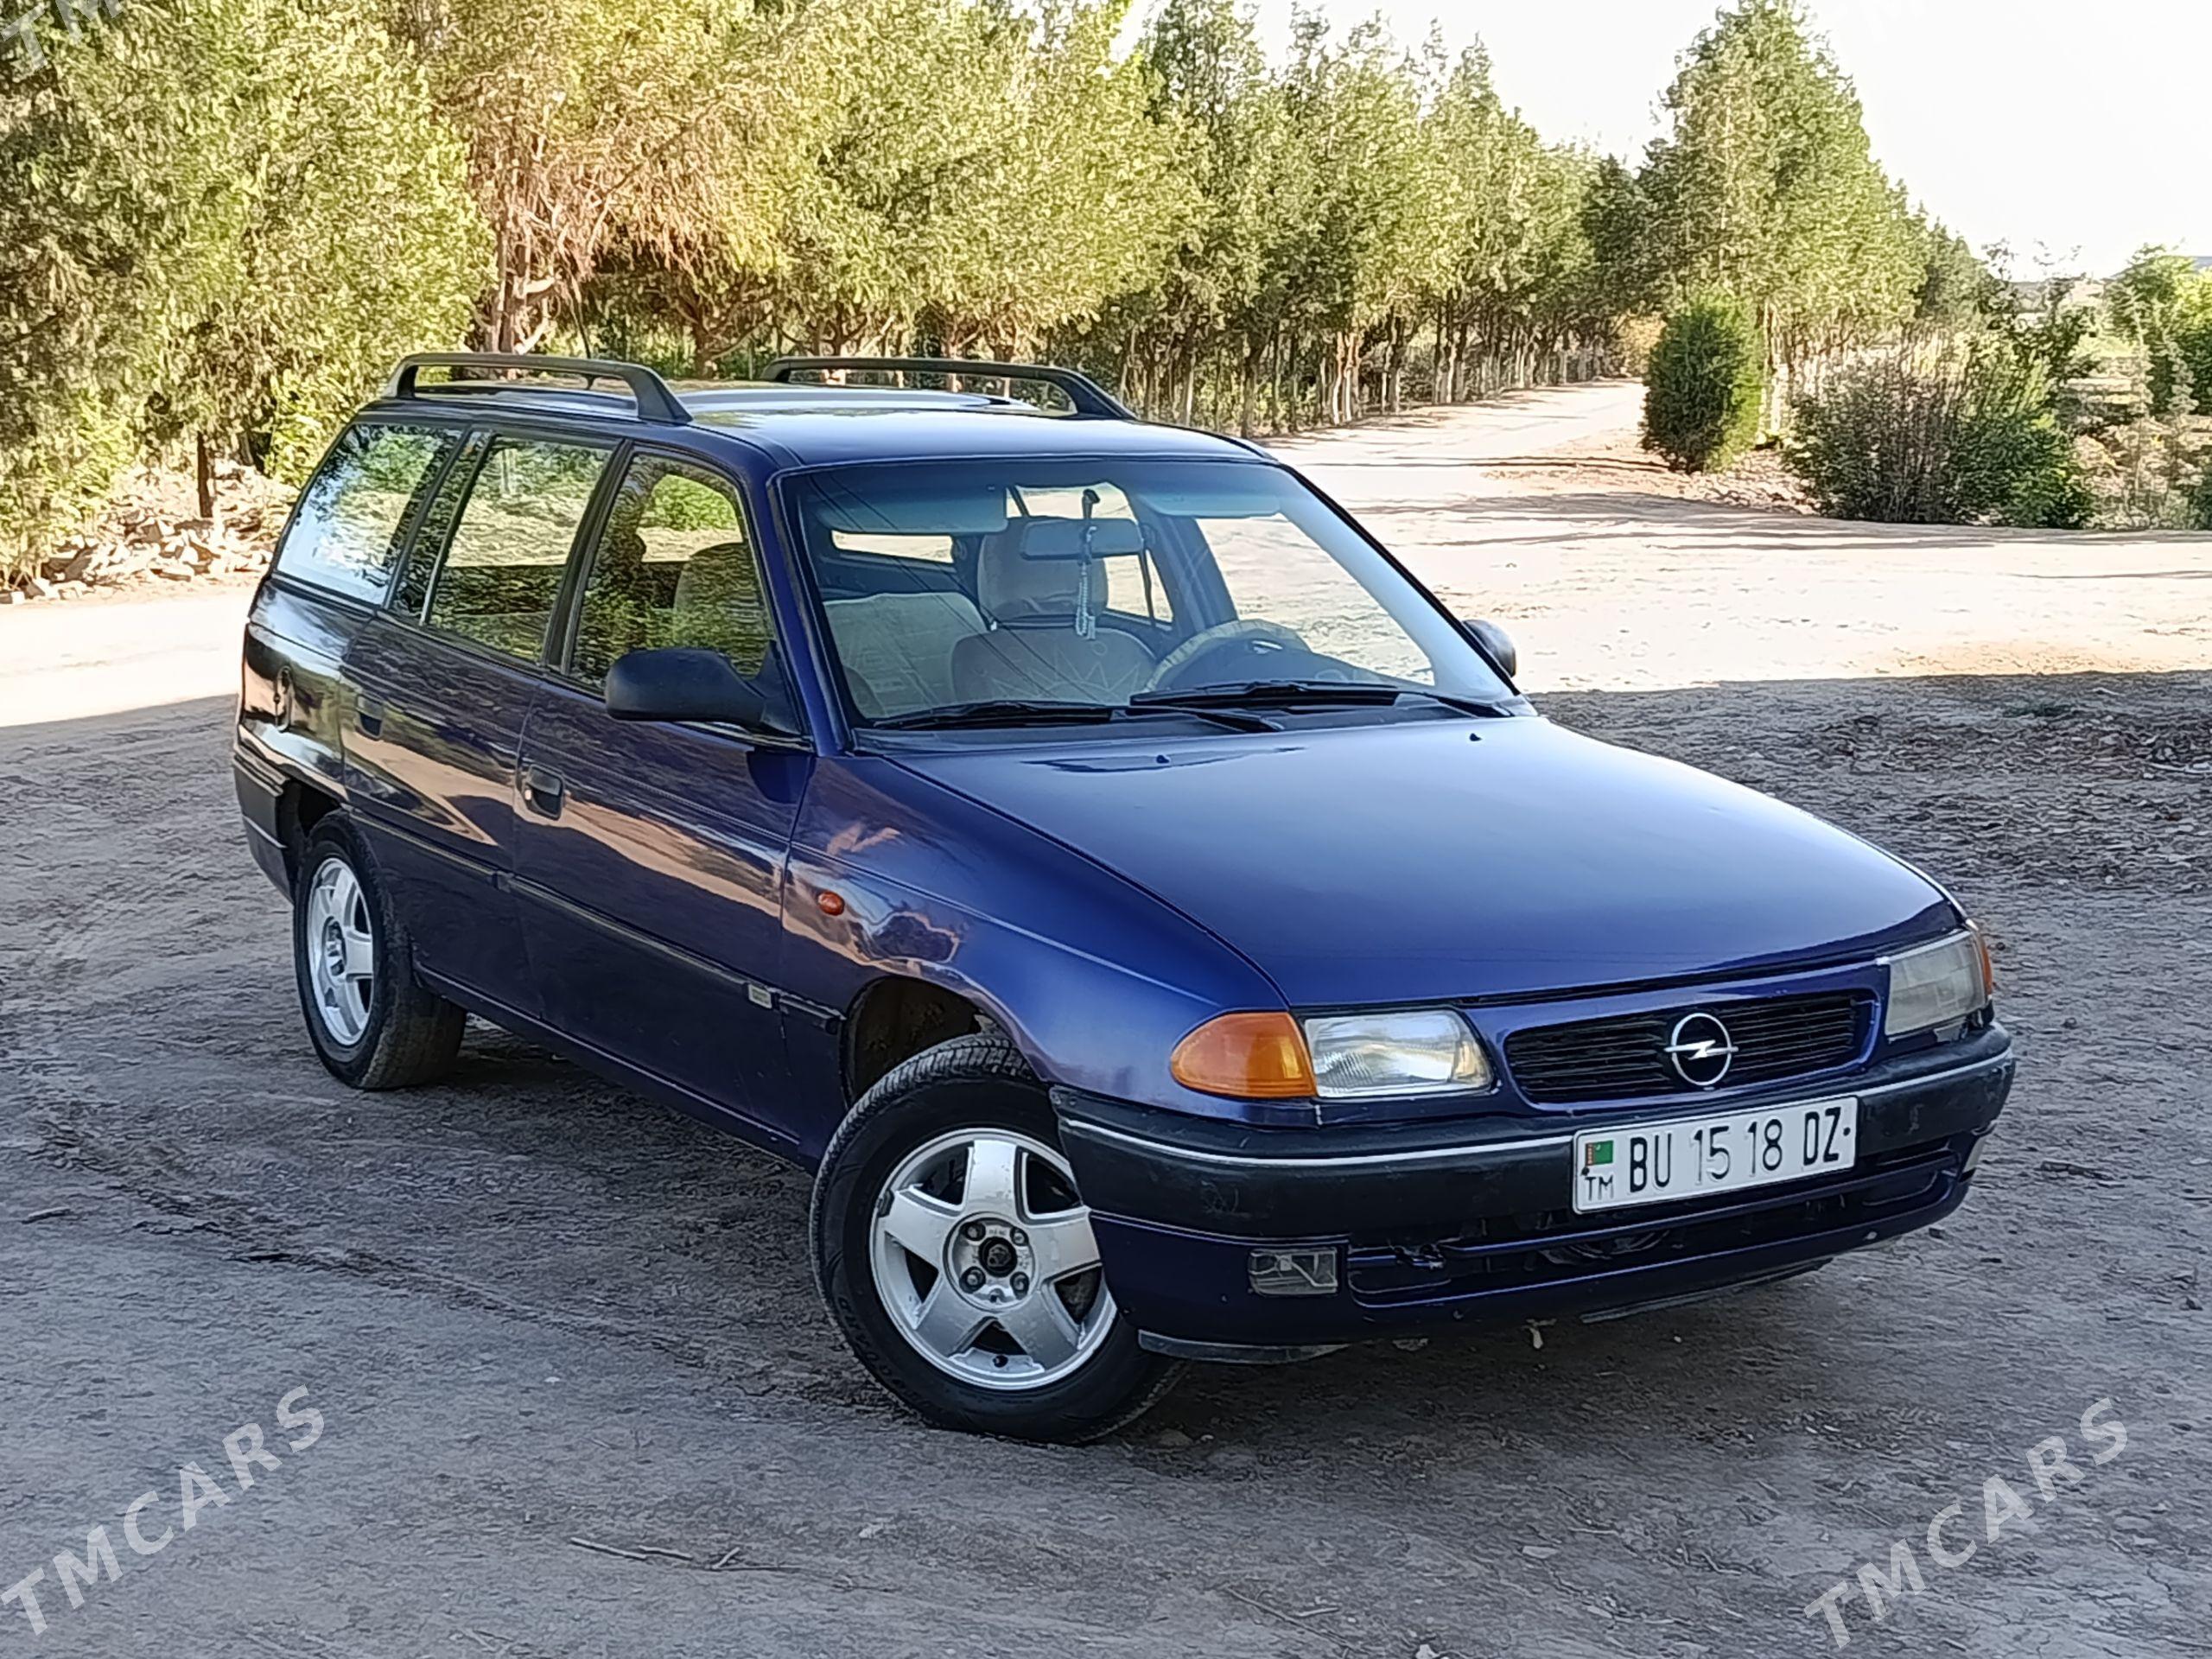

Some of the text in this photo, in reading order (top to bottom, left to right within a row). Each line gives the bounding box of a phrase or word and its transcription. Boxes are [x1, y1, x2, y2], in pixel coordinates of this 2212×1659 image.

[1630, 1106, 1842, 1193] BU 15 18 DZ
[1584, 1174, 1614, 1202] TM
